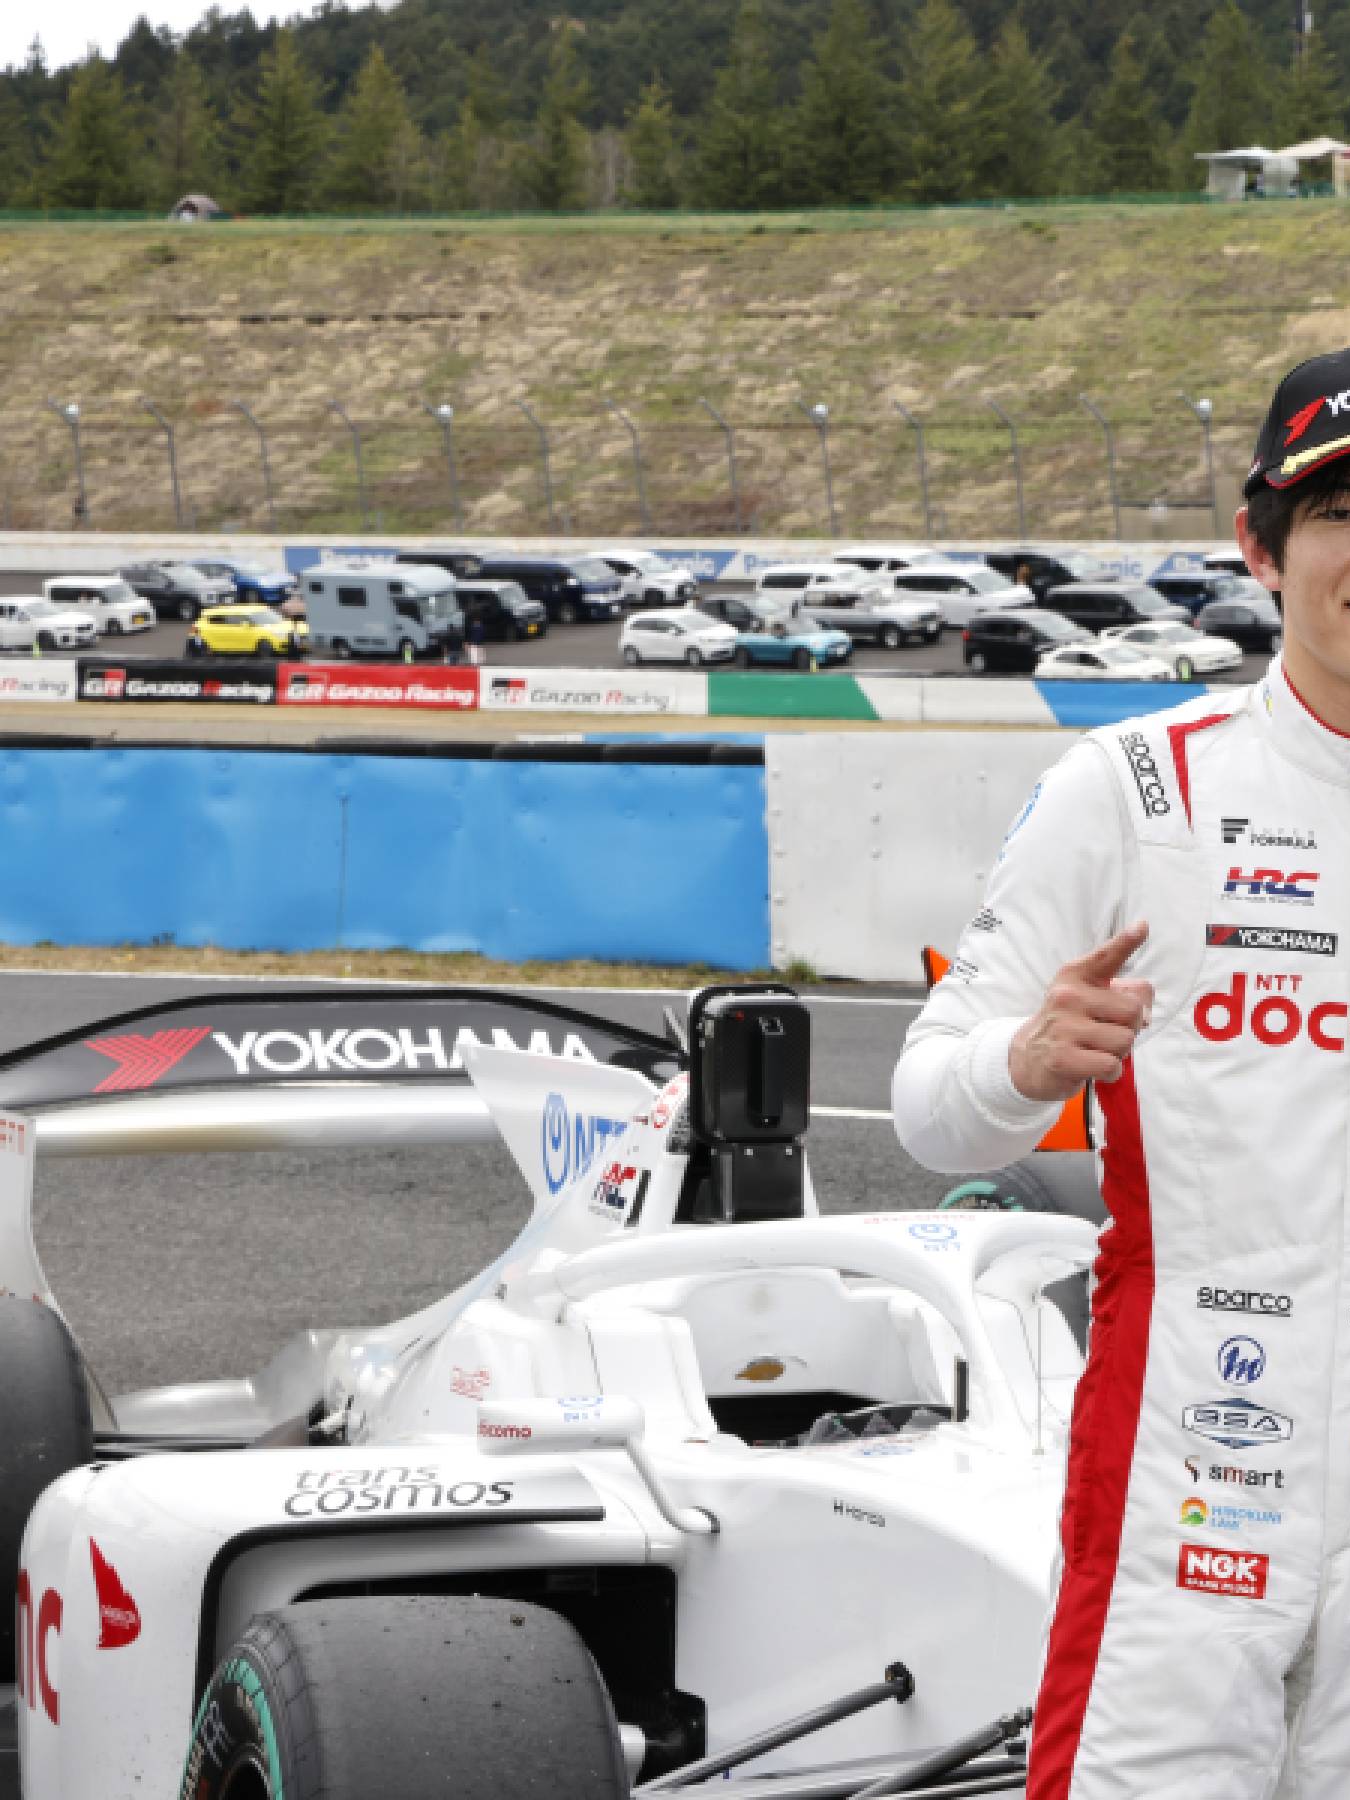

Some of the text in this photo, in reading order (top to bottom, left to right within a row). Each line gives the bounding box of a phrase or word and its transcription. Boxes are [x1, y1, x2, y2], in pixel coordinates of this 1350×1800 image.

[1224, 866, 1320, 898] HRC
[1238, 928, 1334, 953] YOKOHAMA
[1256, 973, 1303, 994] NTT
[1196, 1286, 1294, 1318] sparco
[295, 1464, 440, 1490] trans
[1208, 1464, 1285, 1489] smart
[283, 1480, 515, 1517] cosmos
[1186, 1550, 1258, 1583] NGK
